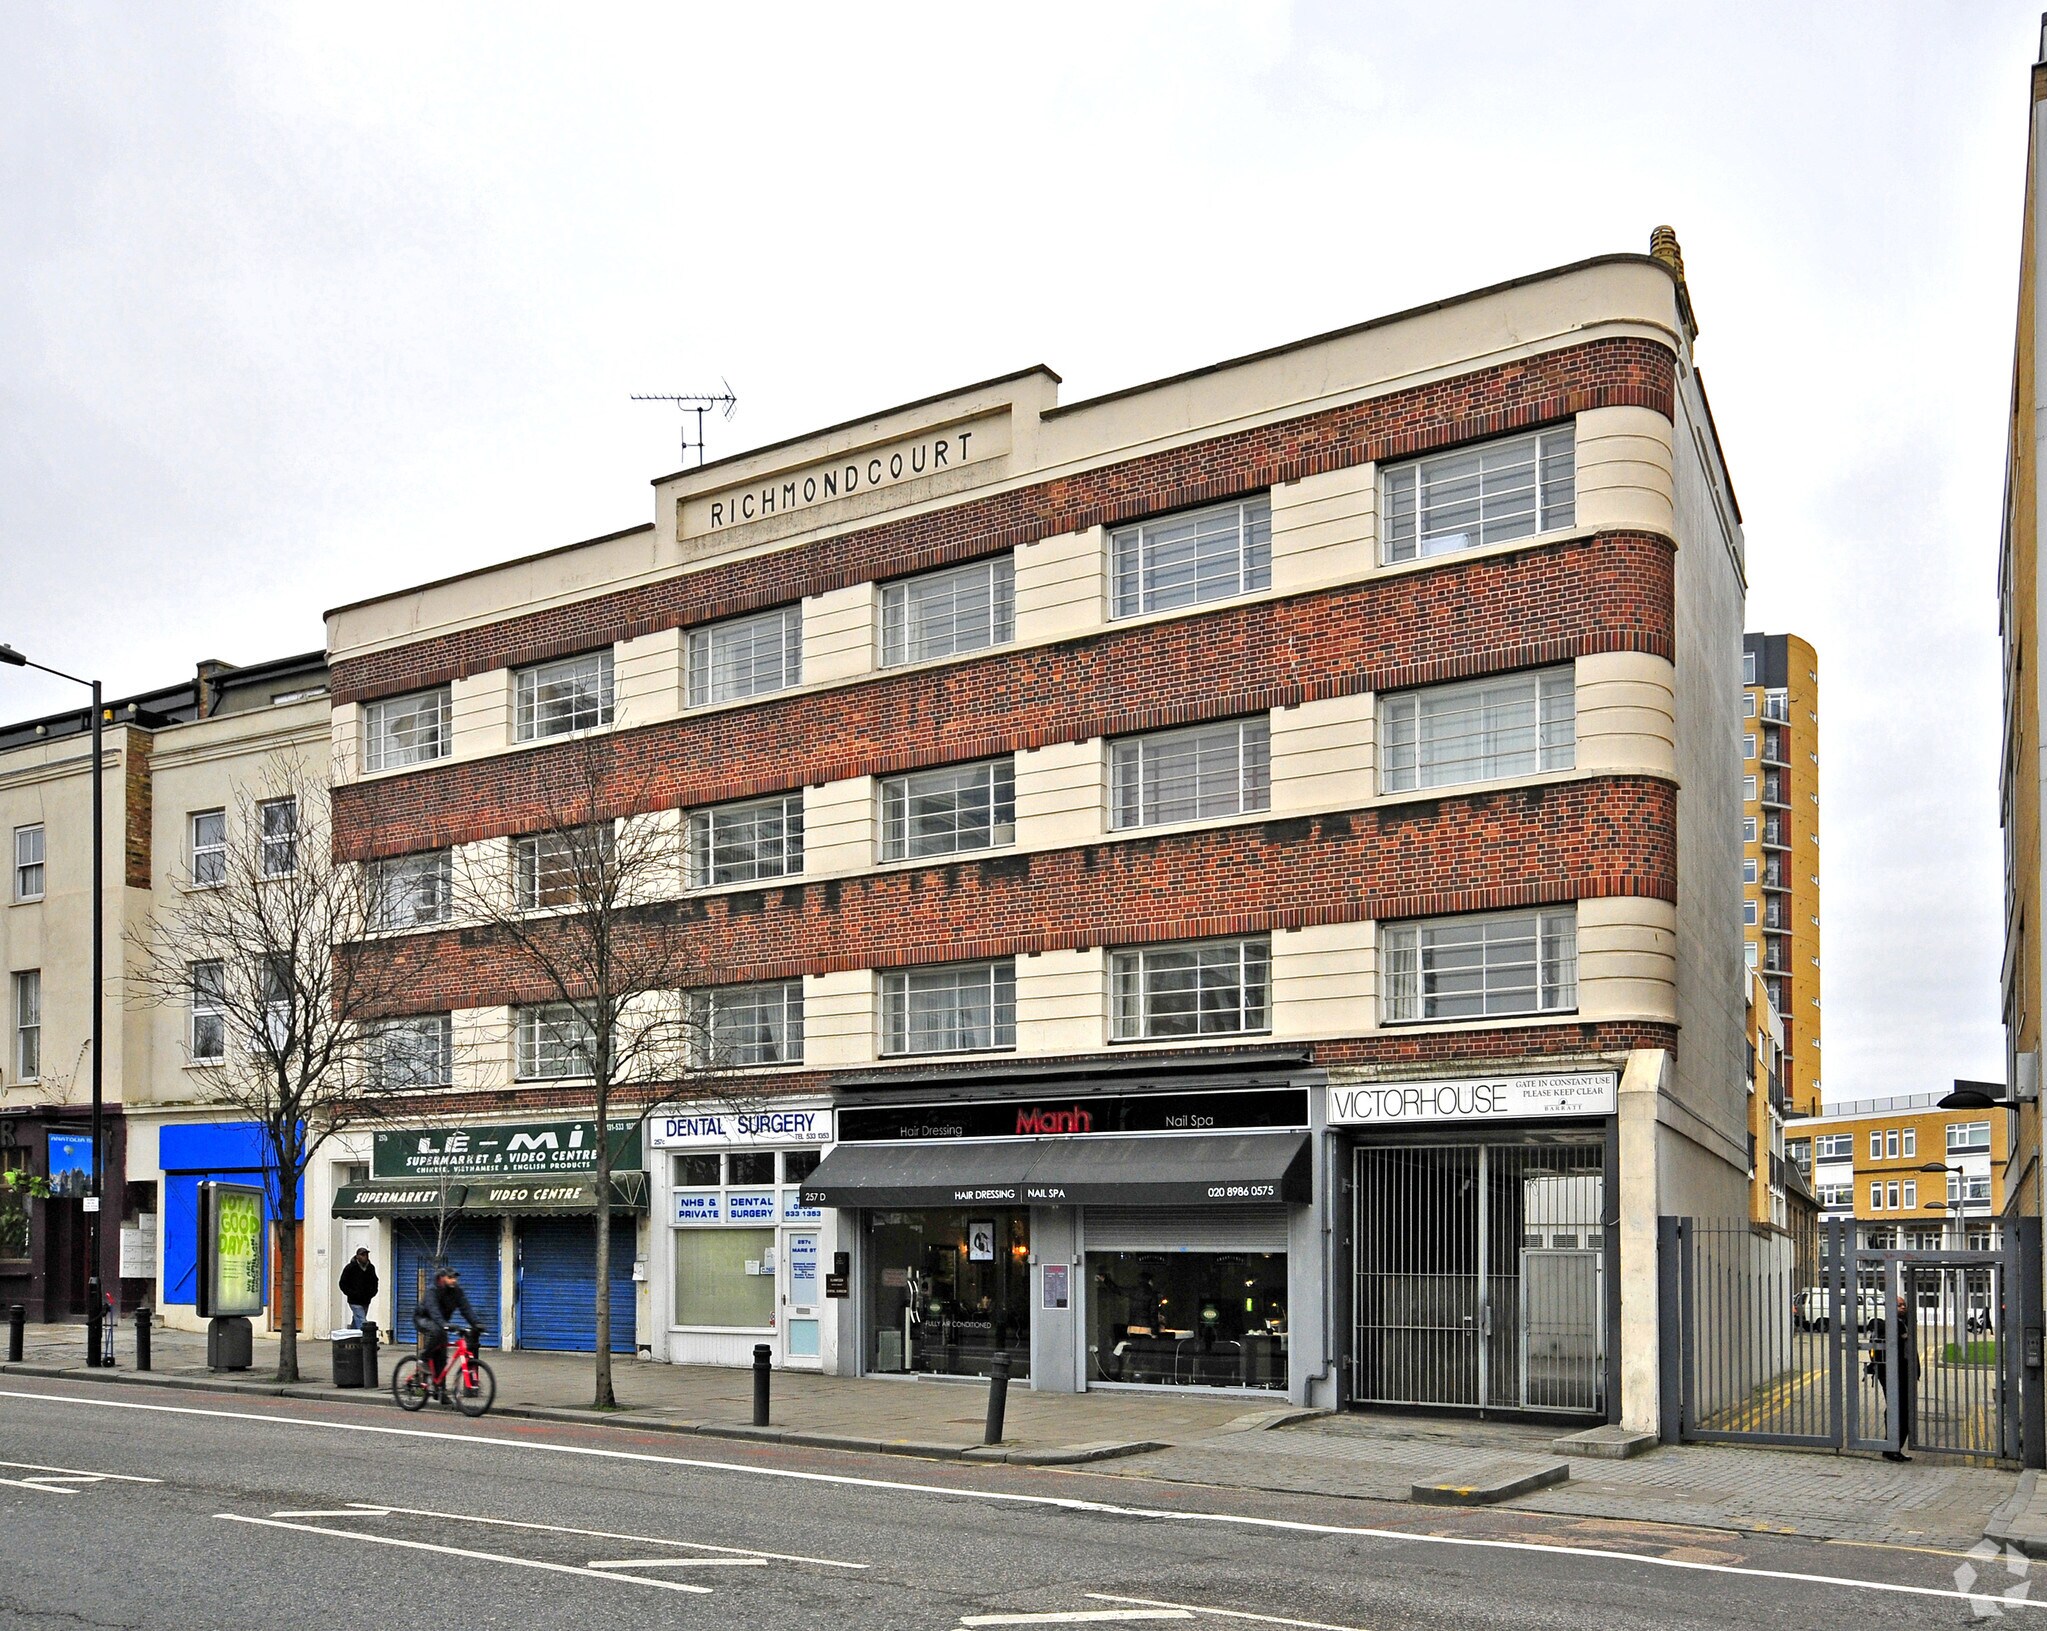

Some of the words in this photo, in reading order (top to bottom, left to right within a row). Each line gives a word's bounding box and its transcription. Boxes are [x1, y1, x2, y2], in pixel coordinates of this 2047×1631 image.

[1515, 1080, 1536, 1088] GATE
[1538, 1079, 1547, 1087] IN
[1549, 1077, 1593, 1087] CONSTANT
[1595, 1076, 1611, 1085] USE
[1523, 1089, 1552, 1098] PLEASE
[1554, 1088, 1575, 1096] KEEP
[1576, 1087, 1604, 1095] CLEAR
[667, 1118, 727, 1138] DENTAL
[738, 1113, 815, 1134] SURGERY
[1015, 1105, 1092, 1135] Manh
[1165, 1115, 1188, 1127] Nail
[1190, 1114, 1214, 1128] Spa
[900, 1126, 919, 1137] Hair
[922, 1125, 963, 1138] Dressing
[406, 1154, 489, 1167] SUPERMARKET
[494, 1153, 503, 1164] &
[509, 1151, 546, 1163] VIDEO
[551, 1149, 598, 1161] CENTRE
[454, 1164, 499, 1173] VIETNAMESE
[550, 1161, 591, 1169] PRODUCTS
[354, 1190, 439, 1204] SUPERMARKET
[489, 1189, 528, 1201] VIDEO
[533, 1187, 582, 1200] CENTRE
[805, 1192, 818, 1201] 257
[820, 1192, 826, 1201] D
[954, 1191, 974, 1200] HAIR
[975, 1189, 1016, 1200] DRESSING
[1027, 1188, 1047, 1198] NAIL
[1048, 1188, 1066, 1198] SPA
[1208, 1187, 1225, 1198] 020
[1226, 1186, 1249, 1197] 8986
[1251, 1185, 1274, 1196] 0575
[219, 1194, 244, 1212] NOT
[246, 1198, 255, 1214] A
[681, 1198, 704, 1207] NHS
[708, 1198, 716, 1206] &
[730, 1198, 774, 1206] DENTAL
[678, 1210, 719, 1218] PRIVATE
[730, 1209, 774, 1218] SURGERY
[221, 1212, 260, 1234] GOOD
[218, 1234, 250, 1256] DAY?
[952, 1321, 992, 1329] CONDITIONED
